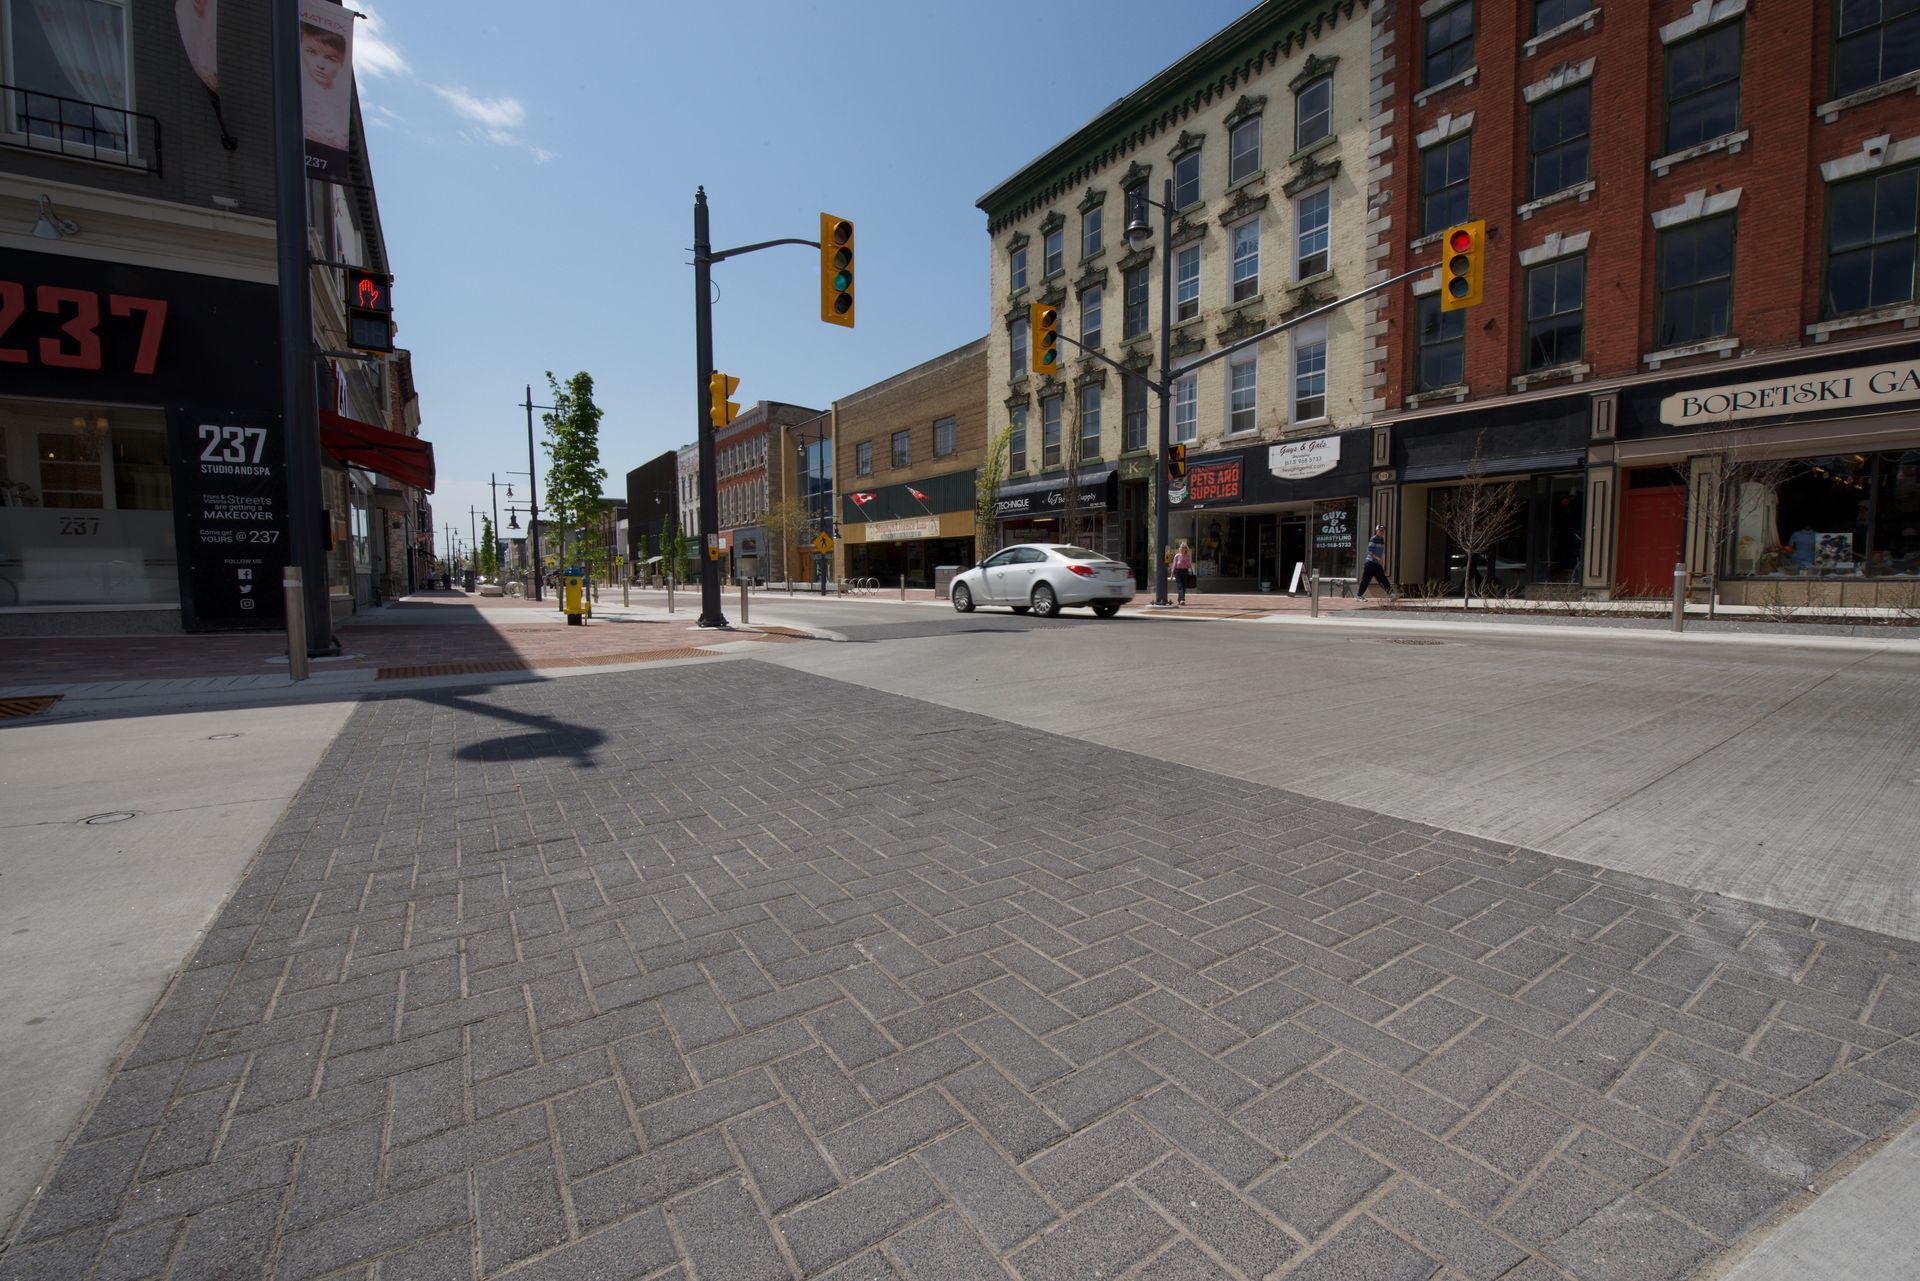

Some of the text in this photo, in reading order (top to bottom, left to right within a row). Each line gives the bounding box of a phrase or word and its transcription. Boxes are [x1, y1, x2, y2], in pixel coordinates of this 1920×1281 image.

[305, 155, 328, 169] 237
[1681, 368, 1920, 418] BORETSKI GA
[198, 424, 267, 464] 237
[1280, 445, 1298, 457] Guys
[1300, 442, 1307, 451] &
[1308, 439, 1327, 453] Gals
[201, 464, 271, 476] STUDIO AND SPA
[1128, 461, 1140, 474] K
[1190, 468, 1239, 487] PETS AND
[1190, 482, 1239, 500] SUPPLIES
[227, 495, 272, 505] Streets
[228, 504, 256, 512] getting
[204, 511, 273, 520] MAKEOVER
[1322, 510, 1347, 521] GUYS
[59, 517, 100, 535] 237
[1321, 524, 1347, 534] GALS
[200, 535, 233, 543] YOURS
[249, 530, 280, 543] 237
